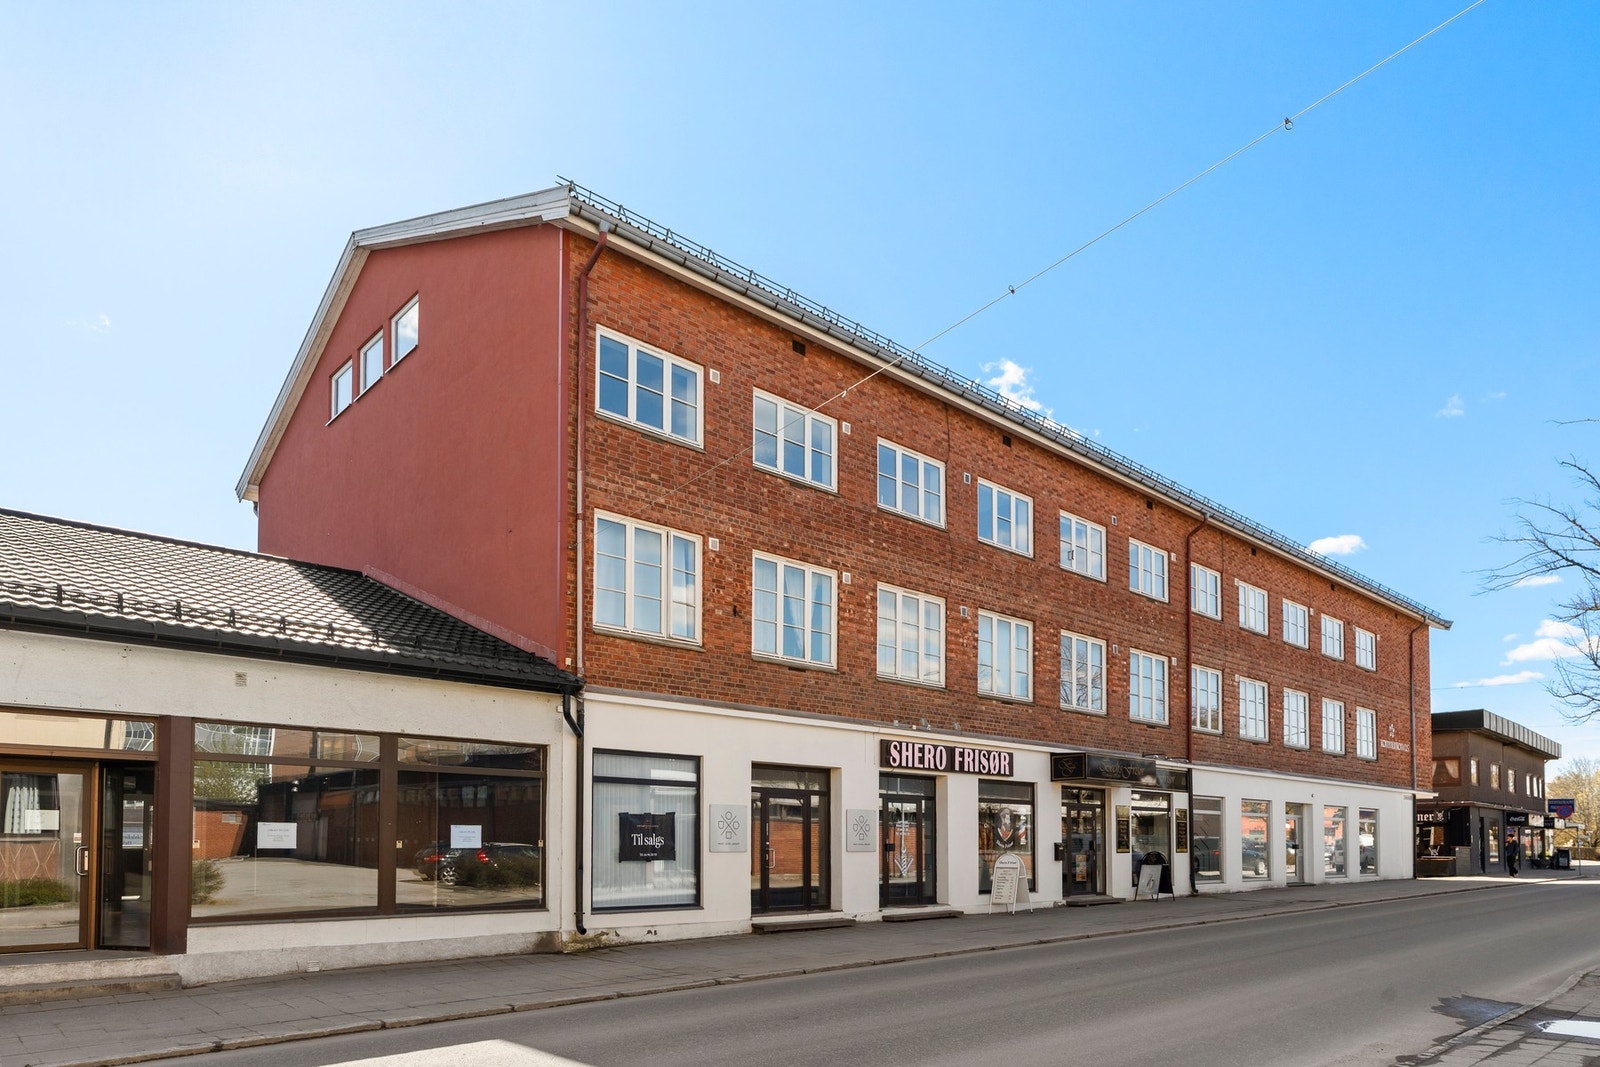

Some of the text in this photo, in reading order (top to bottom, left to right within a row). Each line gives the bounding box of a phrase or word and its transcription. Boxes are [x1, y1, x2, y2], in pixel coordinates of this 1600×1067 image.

[889, 741, 1010, 775] SHERO FRISØR
[631, 833, 665, 849] Til salgs
